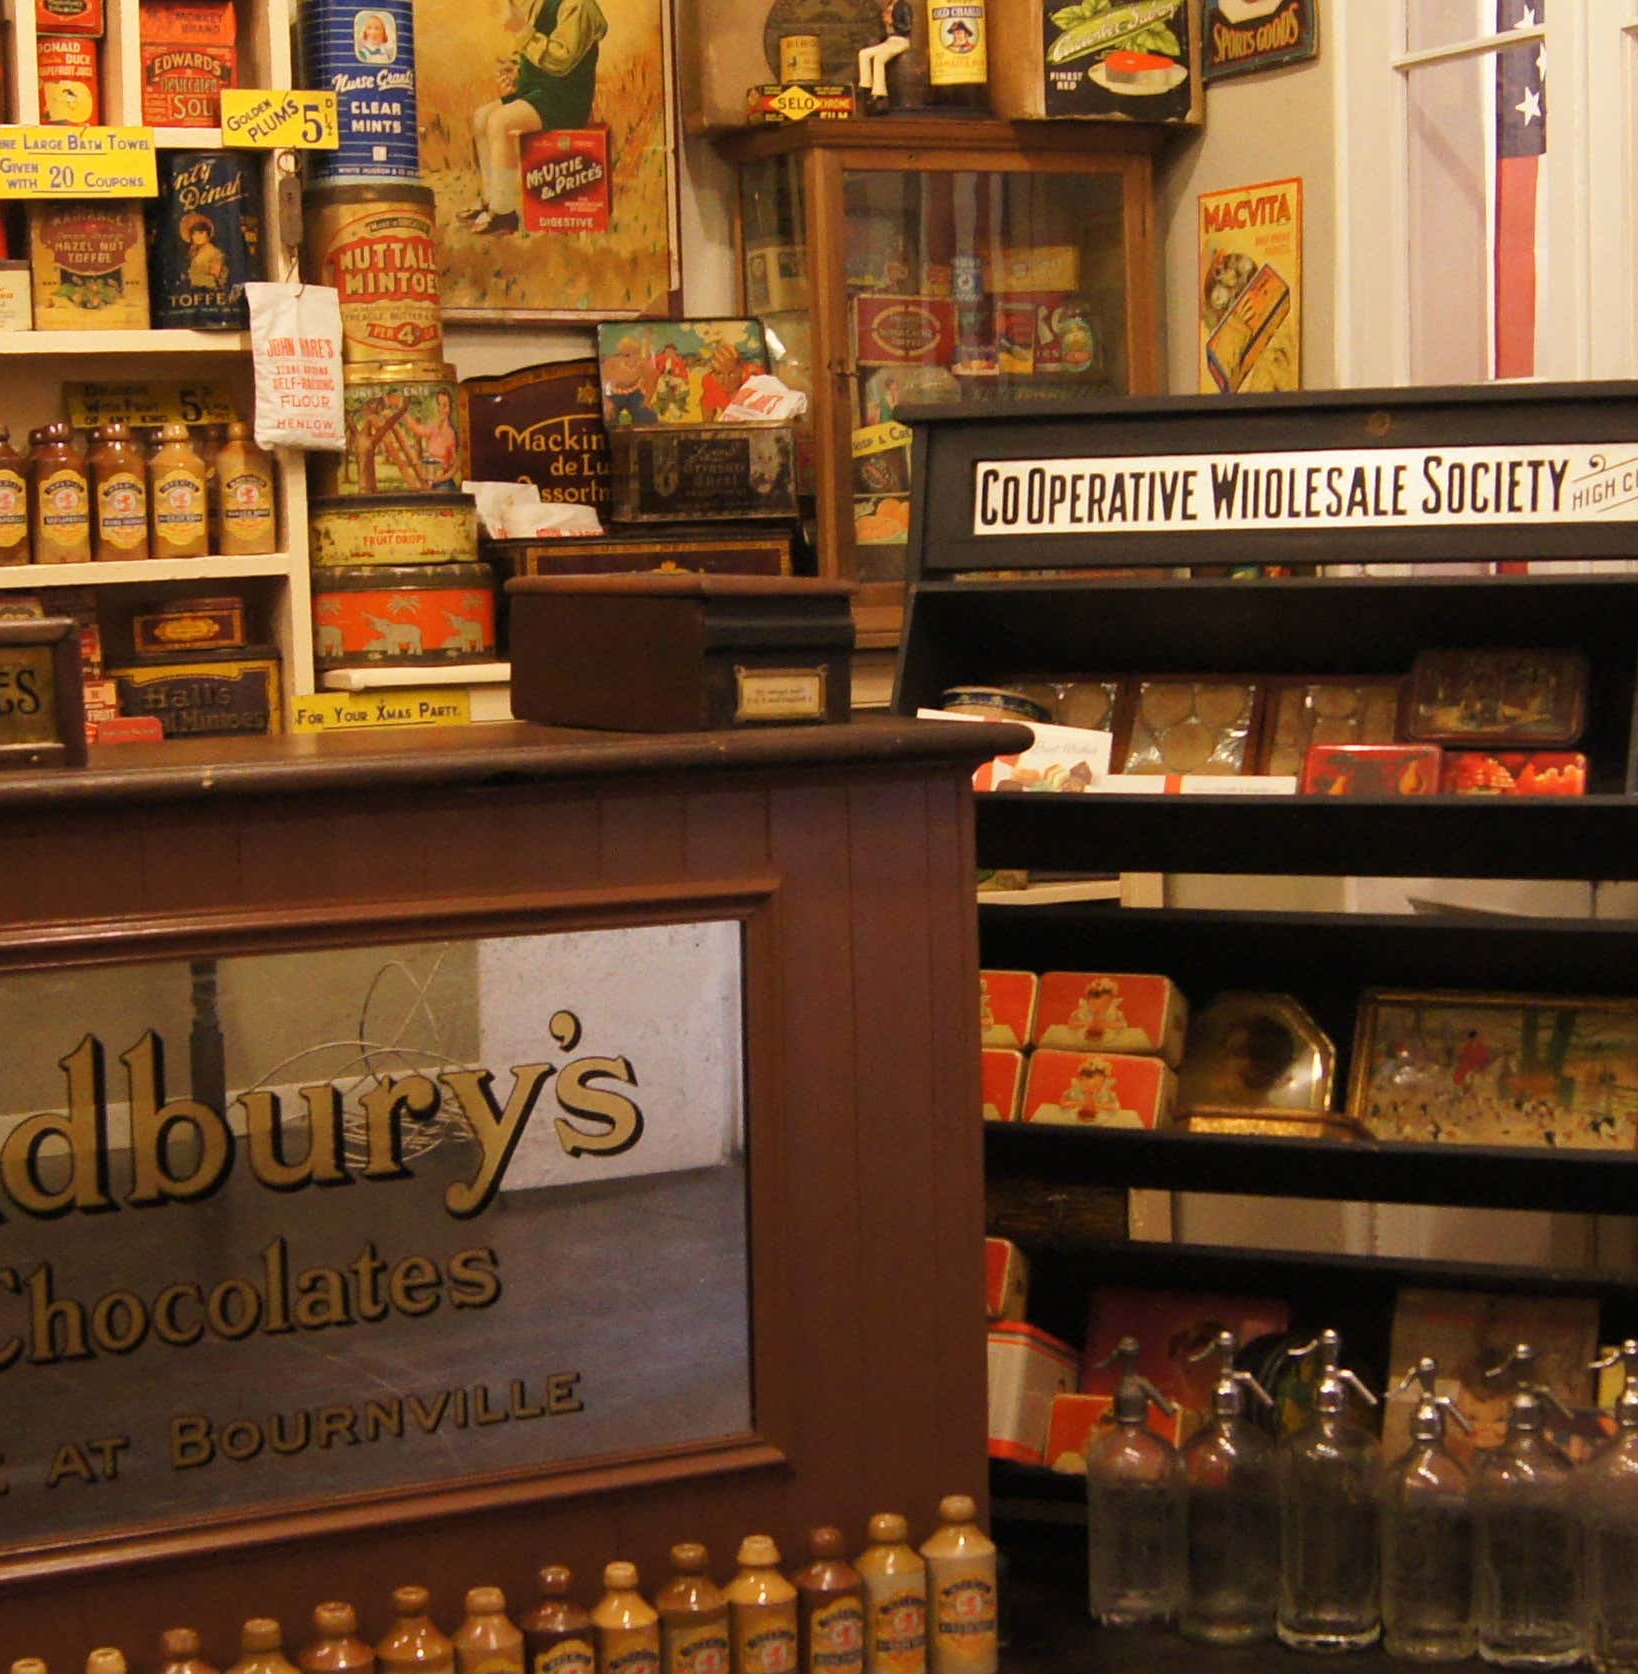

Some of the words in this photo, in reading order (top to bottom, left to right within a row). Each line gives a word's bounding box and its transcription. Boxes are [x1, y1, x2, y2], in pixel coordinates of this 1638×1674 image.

[1212, 22, 1255, 64] SPORTS
[1255, 1, 1300, 52] GOODS
[65, 54, 92, 66] DUCK
[332, 69, 376, 93] Nurse
[1049, 71, 1084, 82] FINEST
[1056, 81, 1078, 91] RED
[350, 100, 403, 116] CLEAR
[777, 97, 814, 111] SELO
[226, 99, 273, 132] GOLDEN
[247, 100, 299, 143] PLUMS
[351, 119, 402, 135] MINTS
[23, 134, 62, 151] LARGE
[67, 135, 103, 152] BATH
[107, 134, 151, 152] TOWEL
[0, 158, 39, 175] GIVEN
[7, 176, 38, 190] WITH
[48, 165, 75, 189] 20
[538, 216, 594, 228] DIGESTIVE
[267, 338, 295, 358] JOHN
[280, 395, 332, 409] FLOUR
[276, 418, 334, 431] HENLOW
[550, 455, 577, 477] de
[1421, 454, 1570, 516] SOCIETY
[1572, 479, 1617, 512] HIGH
[363, 535, 395, 547] FRUIT
[296, 708, 324, 725] FOR
[333, 705, 368, 723] YOUR
[376, 702, 412, 721] XMAS
[45, 1435, 132, 1490] AT
[171, 1370, 583, 1473] BOURNVILLE
